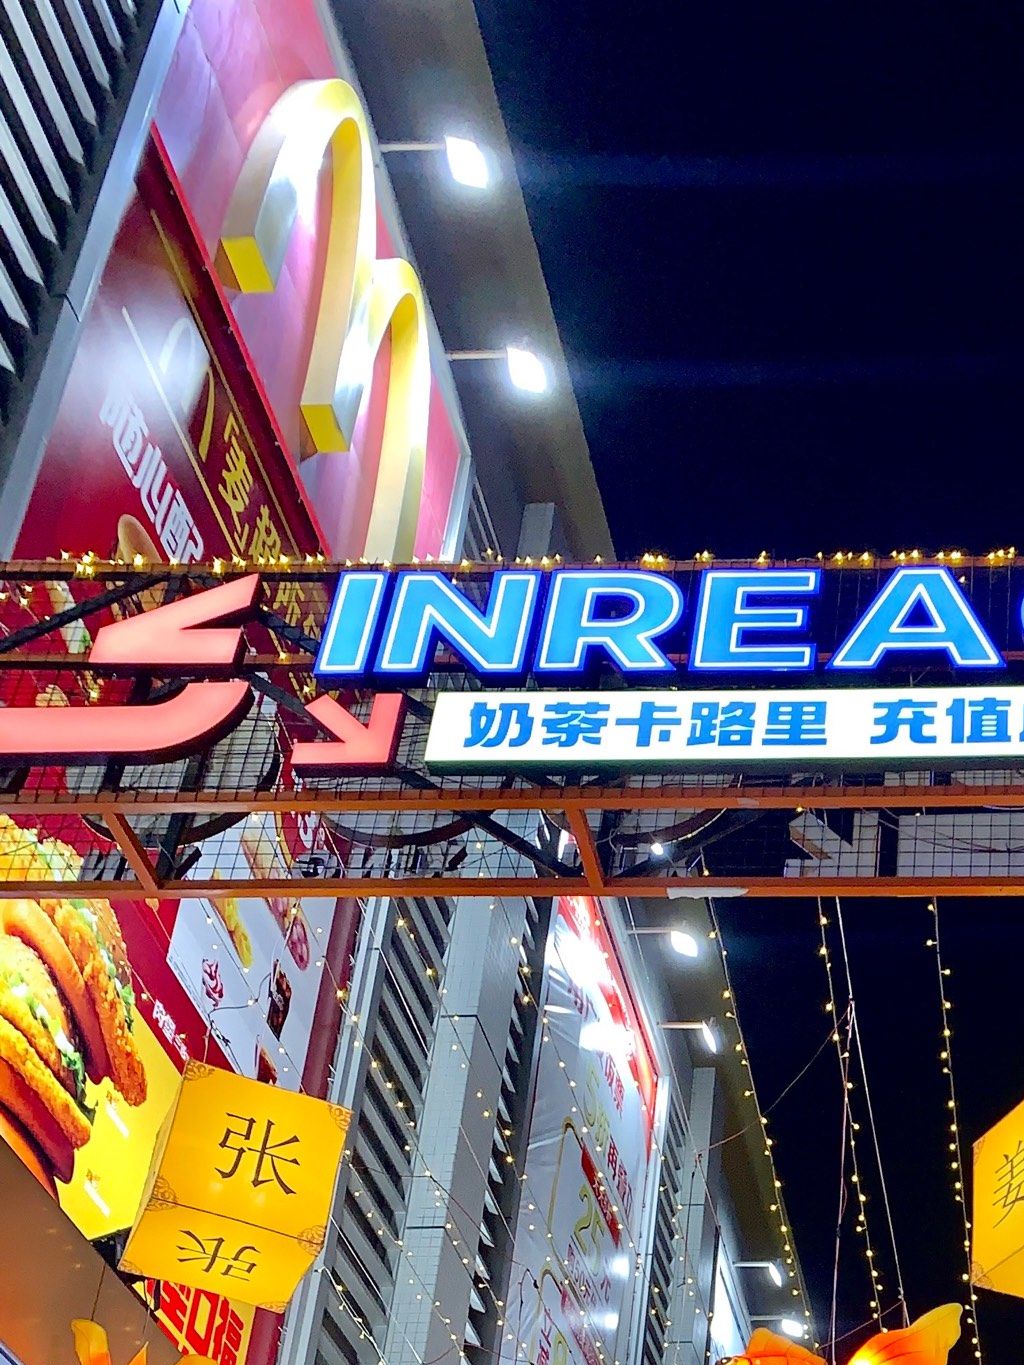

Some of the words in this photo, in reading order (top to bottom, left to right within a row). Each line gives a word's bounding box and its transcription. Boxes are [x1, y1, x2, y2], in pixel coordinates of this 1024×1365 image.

[463, 698, 828, 750] 奶茶卡路里
[214, 1111, 301, 1196] 张
